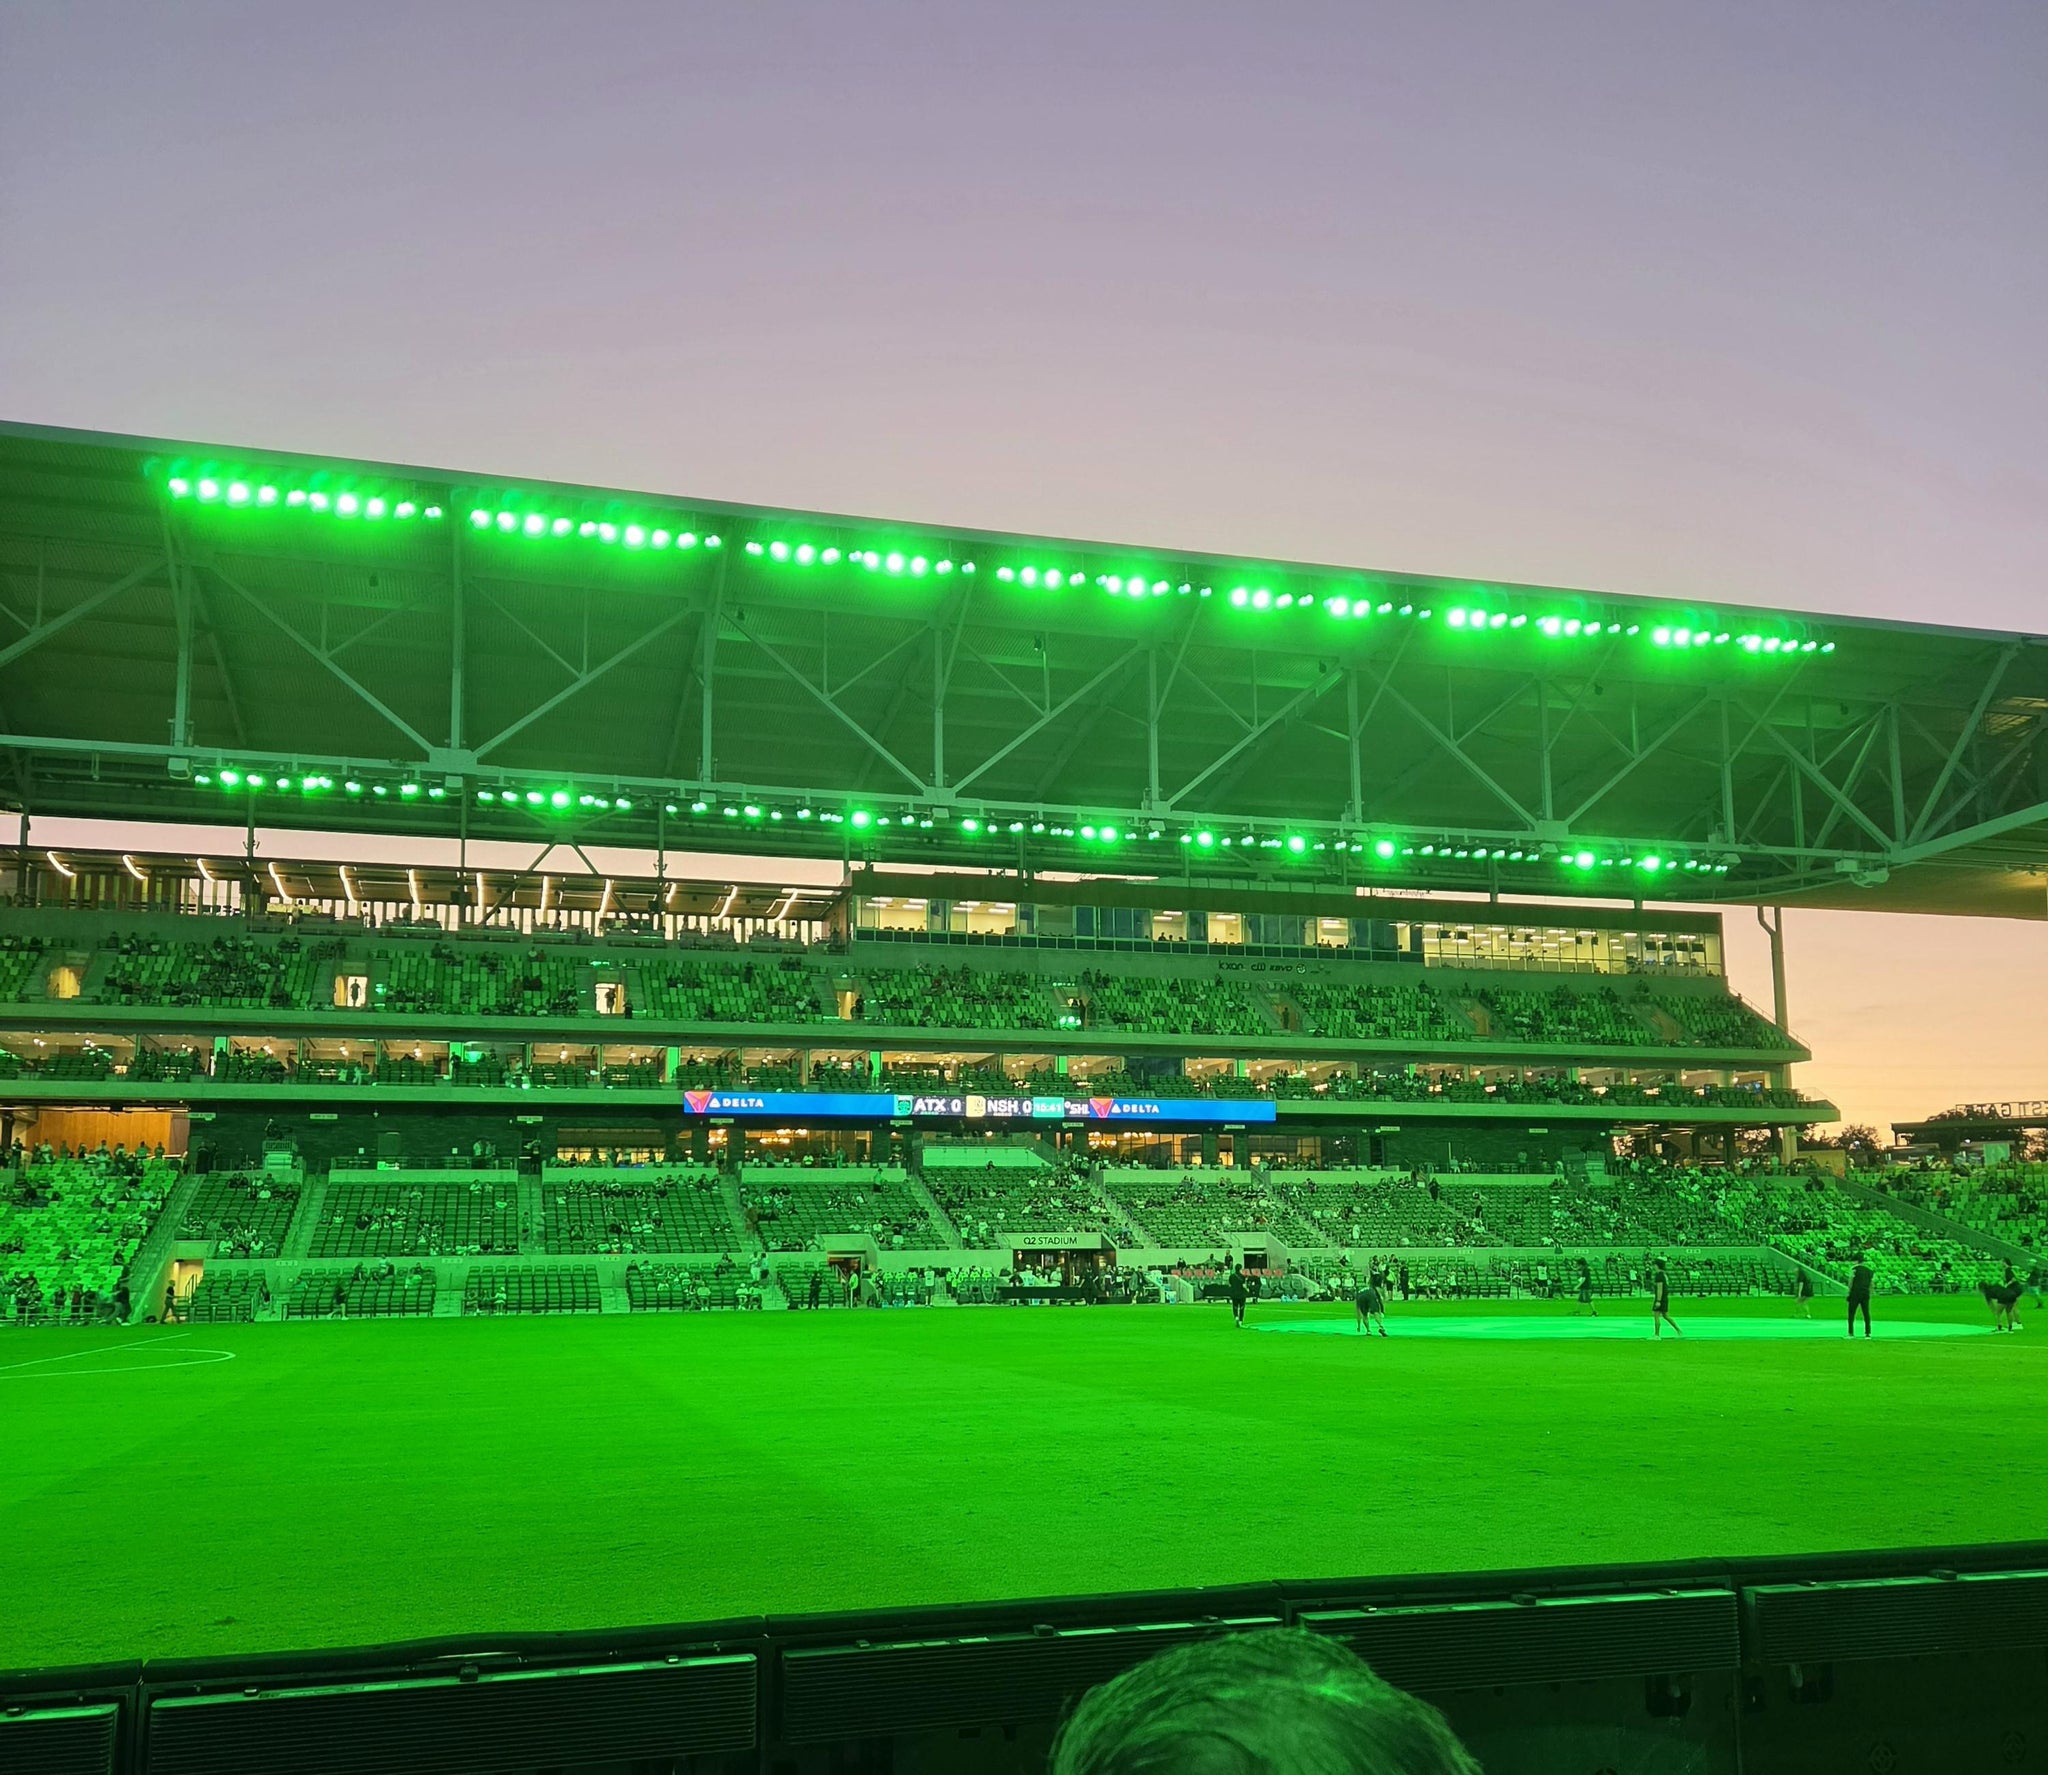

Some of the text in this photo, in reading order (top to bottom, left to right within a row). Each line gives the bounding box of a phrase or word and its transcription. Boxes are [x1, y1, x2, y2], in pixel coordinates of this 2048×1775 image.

[722, 1098, 764, 1108] DELTA
[914, 1098, 947, 1112] ATX
[950, 1099, 962, 1112] 0
[987, 1100, 1019, 1113] NSH
[1022, 1100, 1032, 1113] 0
[1122, 1103, 1160, 1114] DELTA
[1023, 1237, 1077, 1245] Q2 STADIUM
